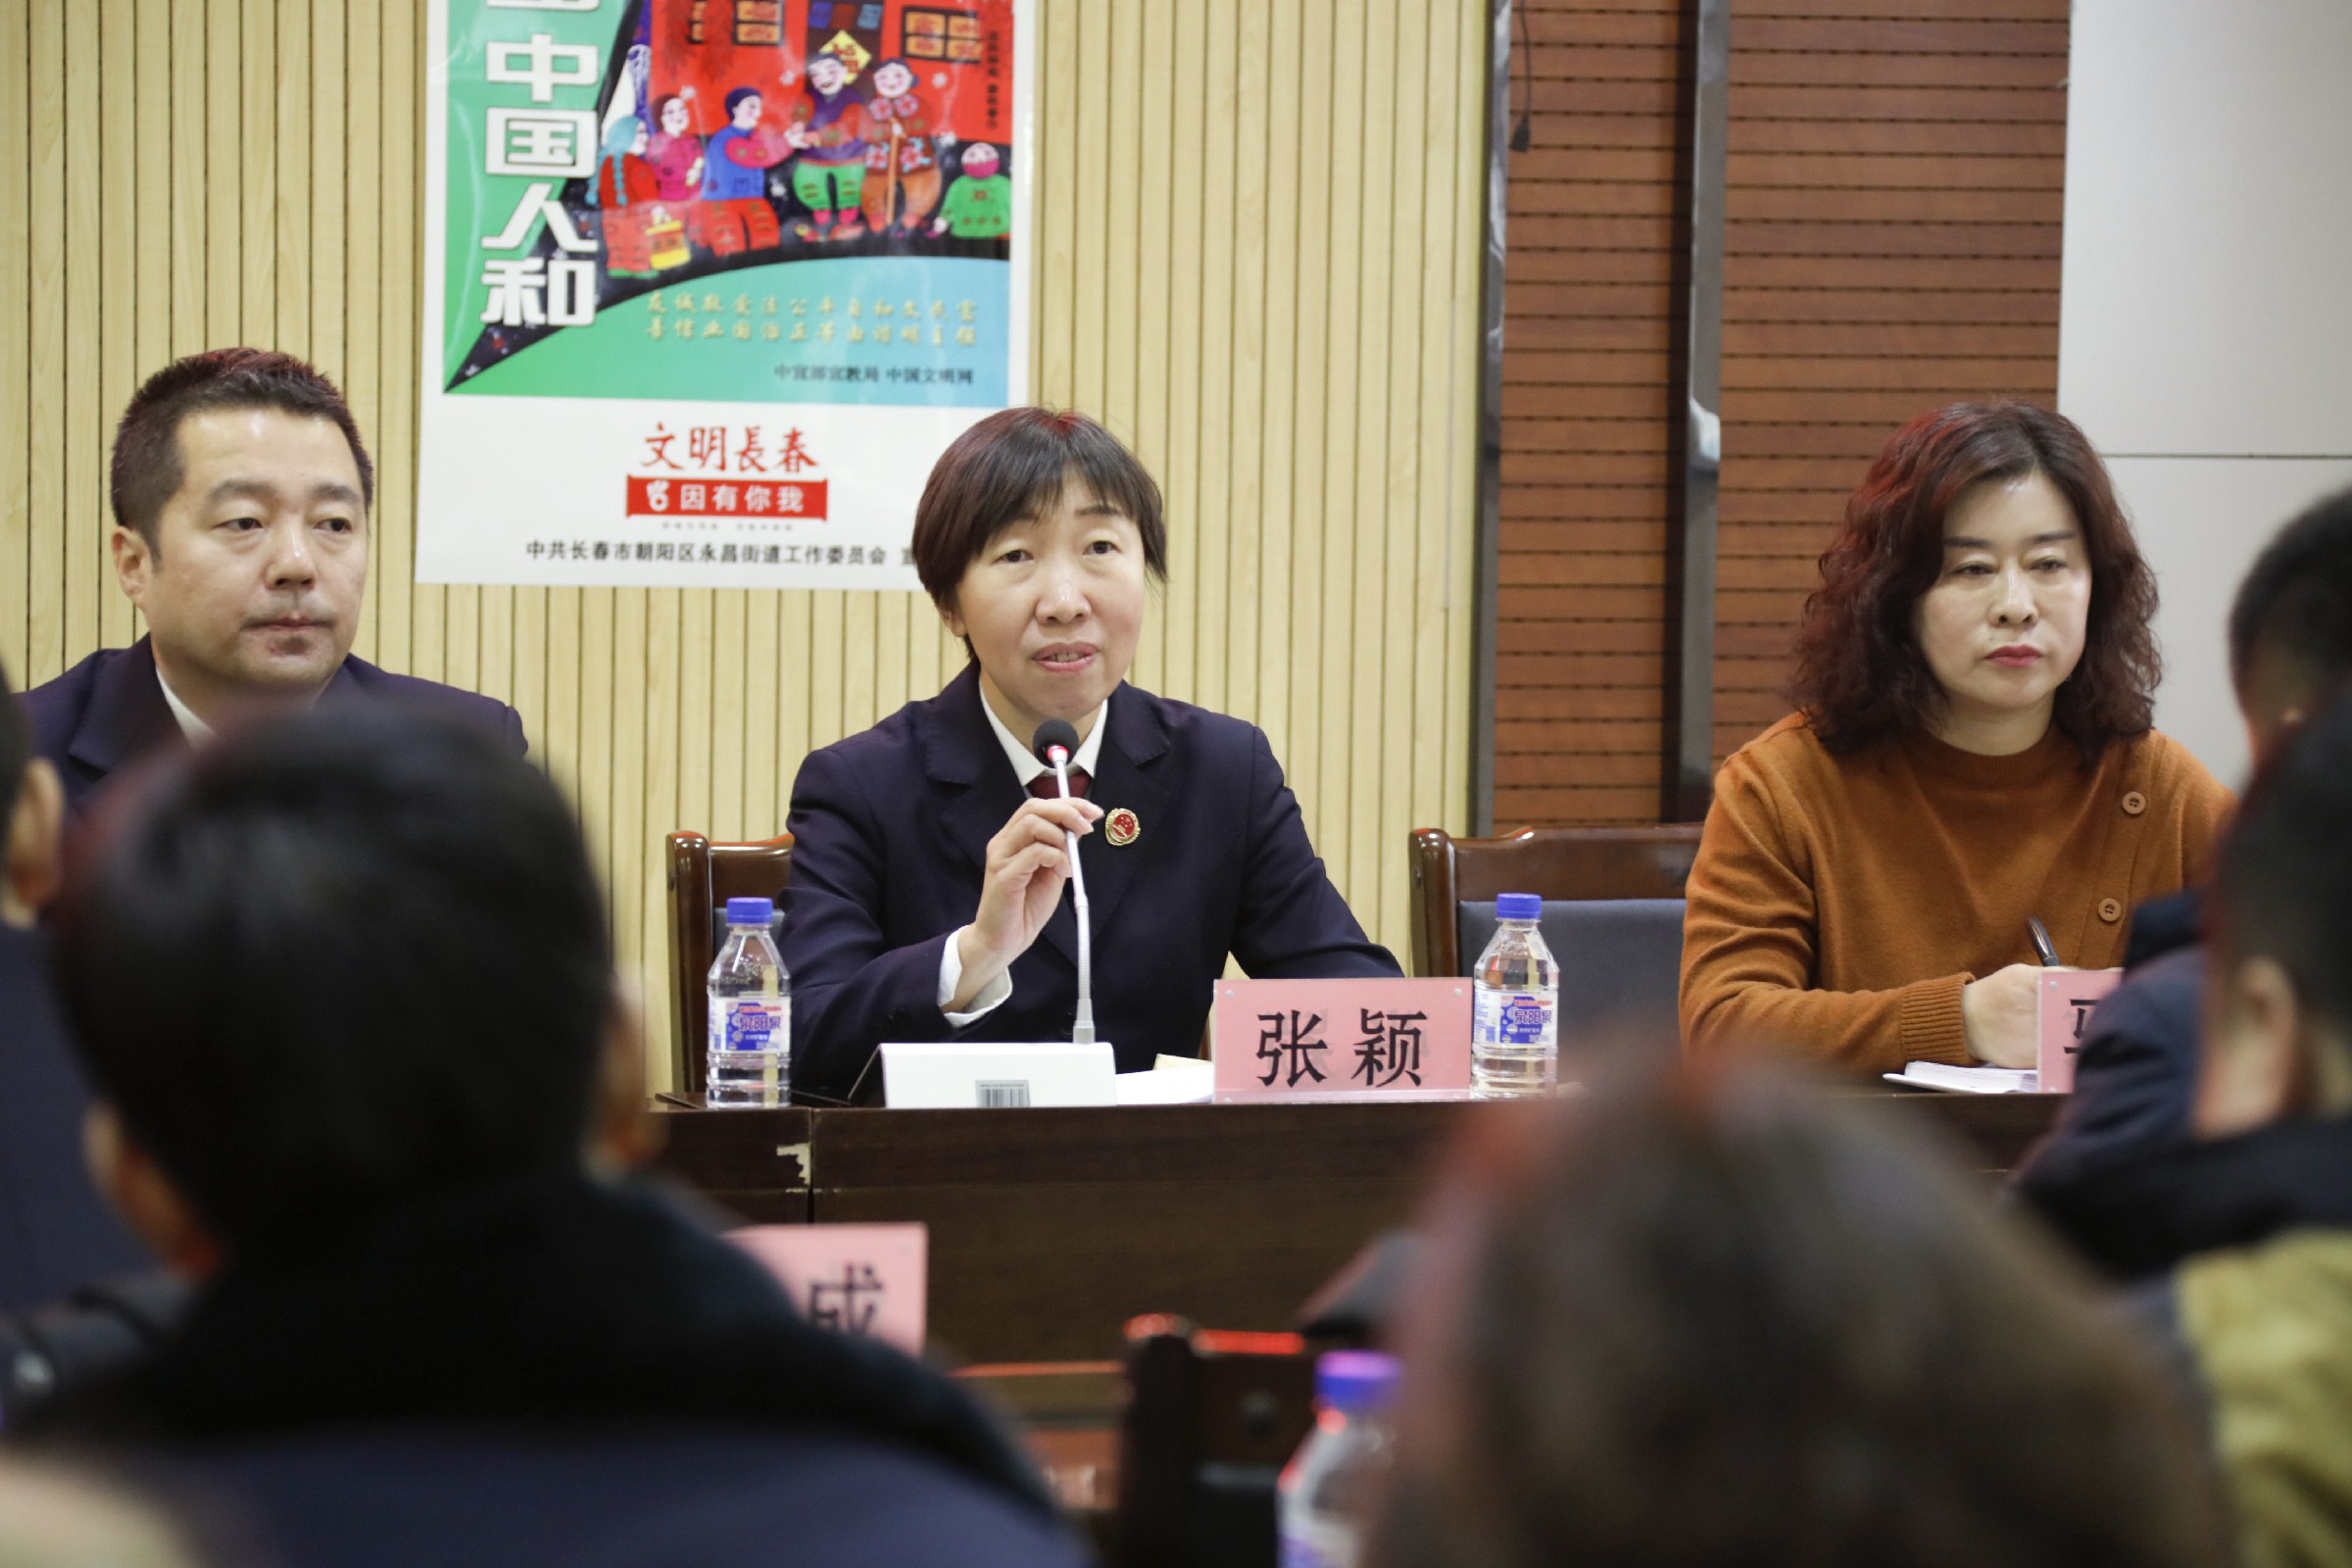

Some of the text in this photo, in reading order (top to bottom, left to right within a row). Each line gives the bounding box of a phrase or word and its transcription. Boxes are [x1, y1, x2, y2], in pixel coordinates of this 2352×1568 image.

[481, 0, 601, 328] 中国人和
[774, 364, 973, 384] 中宣部宣教局 中国文明网
[526, 539, 886, 565] 中共长春市朝阳区永昌街道工作委员会
[1515, 1009, 1552, 1024] 泉阳泉
[1256, 1007, 1429, 1088] 张颖
